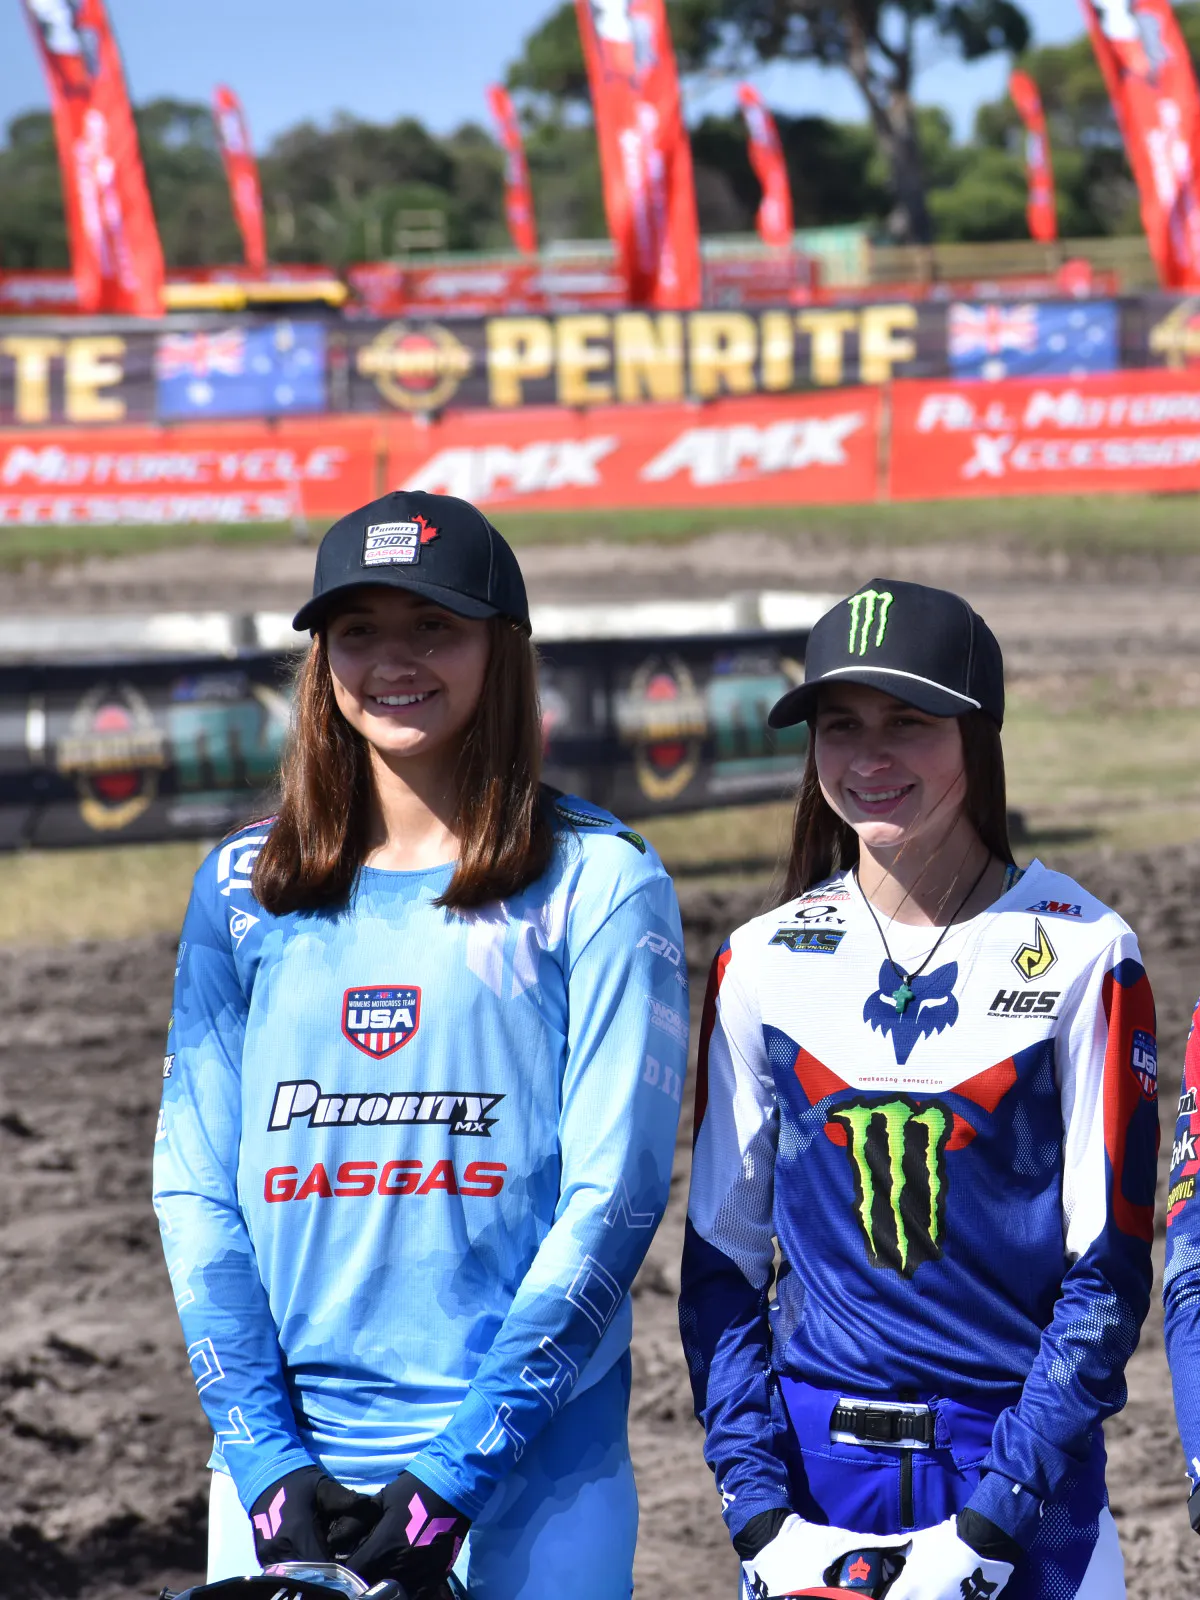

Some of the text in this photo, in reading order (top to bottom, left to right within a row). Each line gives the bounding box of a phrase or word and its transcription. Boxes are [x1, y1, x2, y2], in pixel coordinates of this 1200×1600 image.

[485, 306, 917, 408] PENRITE
[401, 412, 865, 500] AMX AMX
[372, 536, 412, 548] THOR
[366, 549, 413, 558] GASGAS
[1025, 900, 1082, 915] AMA
[402, 999, 416, 1007] TEAM
[989, 989, 1061, 1013] HGS
[348, 1008, 414, 1029] USA
[267, 1080, 506, 1131] PRIORITY
[454, 1121, 486, 1133] MX
[264, 1160, 507, 1203] GASGAS
